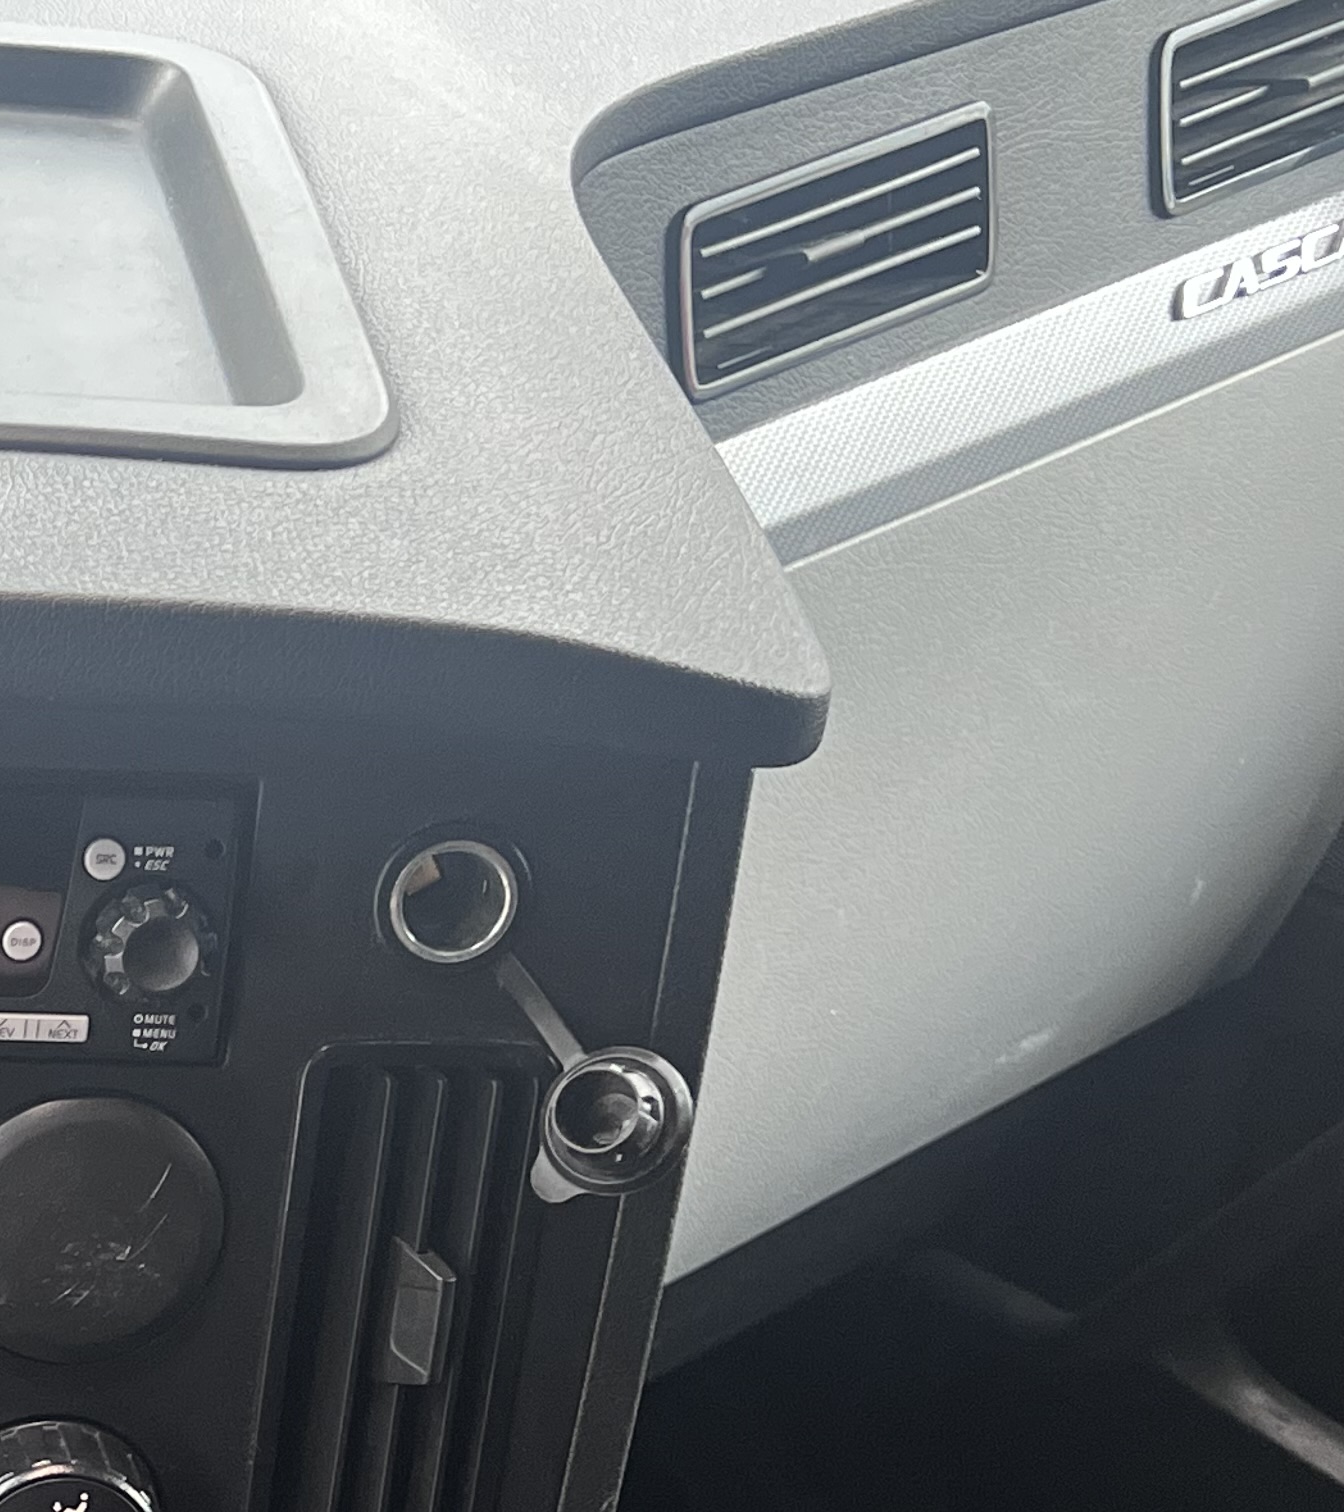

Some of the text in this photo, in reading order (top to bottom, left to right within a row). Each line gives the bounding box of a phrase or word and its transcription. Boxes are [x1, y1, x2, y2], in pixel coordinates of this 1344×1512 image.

[1174, 223, 1344, 320] CASC
[146, 847, 174, 857] PWR
[96, 853, 116, 865] SRC
[144, 860, 170, 870] ESC
[11, 938, 36, 947] DISP
[144, 1014, 176, 1025] MUTE
[48, 1028, 78, 1039] NEXT
[142, 1029, 176, 1039] MENU
[149, 1041, 168, 1051] OK
